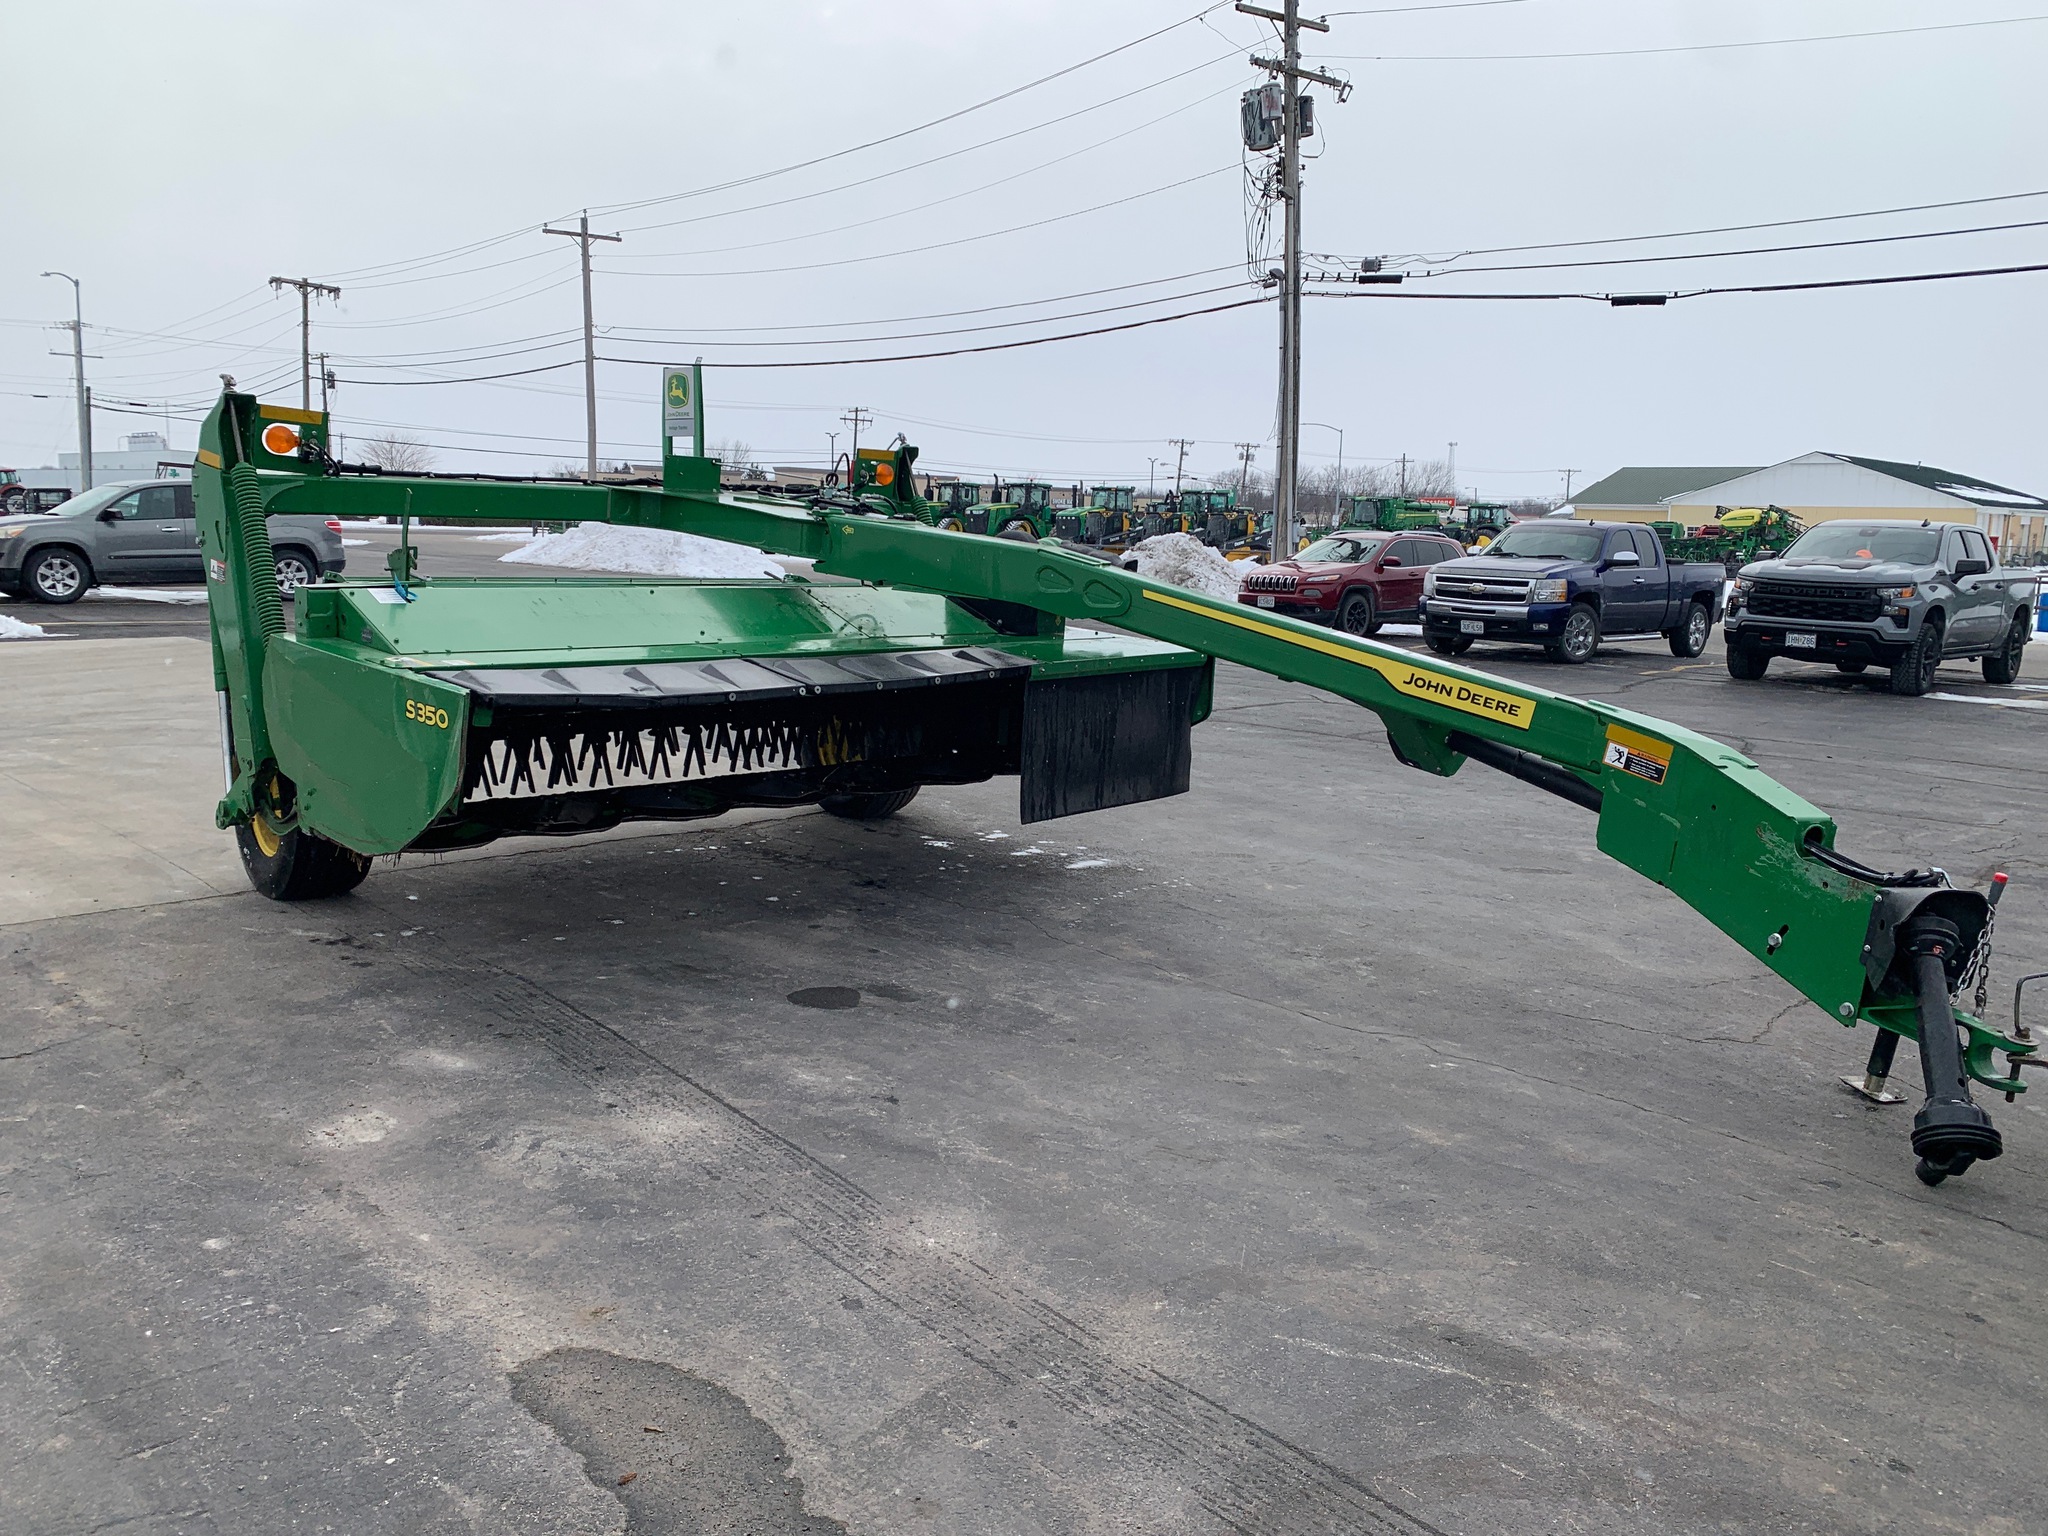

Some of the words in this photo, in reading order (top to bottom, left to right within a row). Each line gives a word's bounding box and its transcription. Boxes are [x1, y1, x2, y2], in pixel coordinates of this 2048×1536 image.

[1403, 673, 1453, 697] JOHN
[1456, 686, 1521, 717] DEERE
[405, 699, 449, 729] S350
